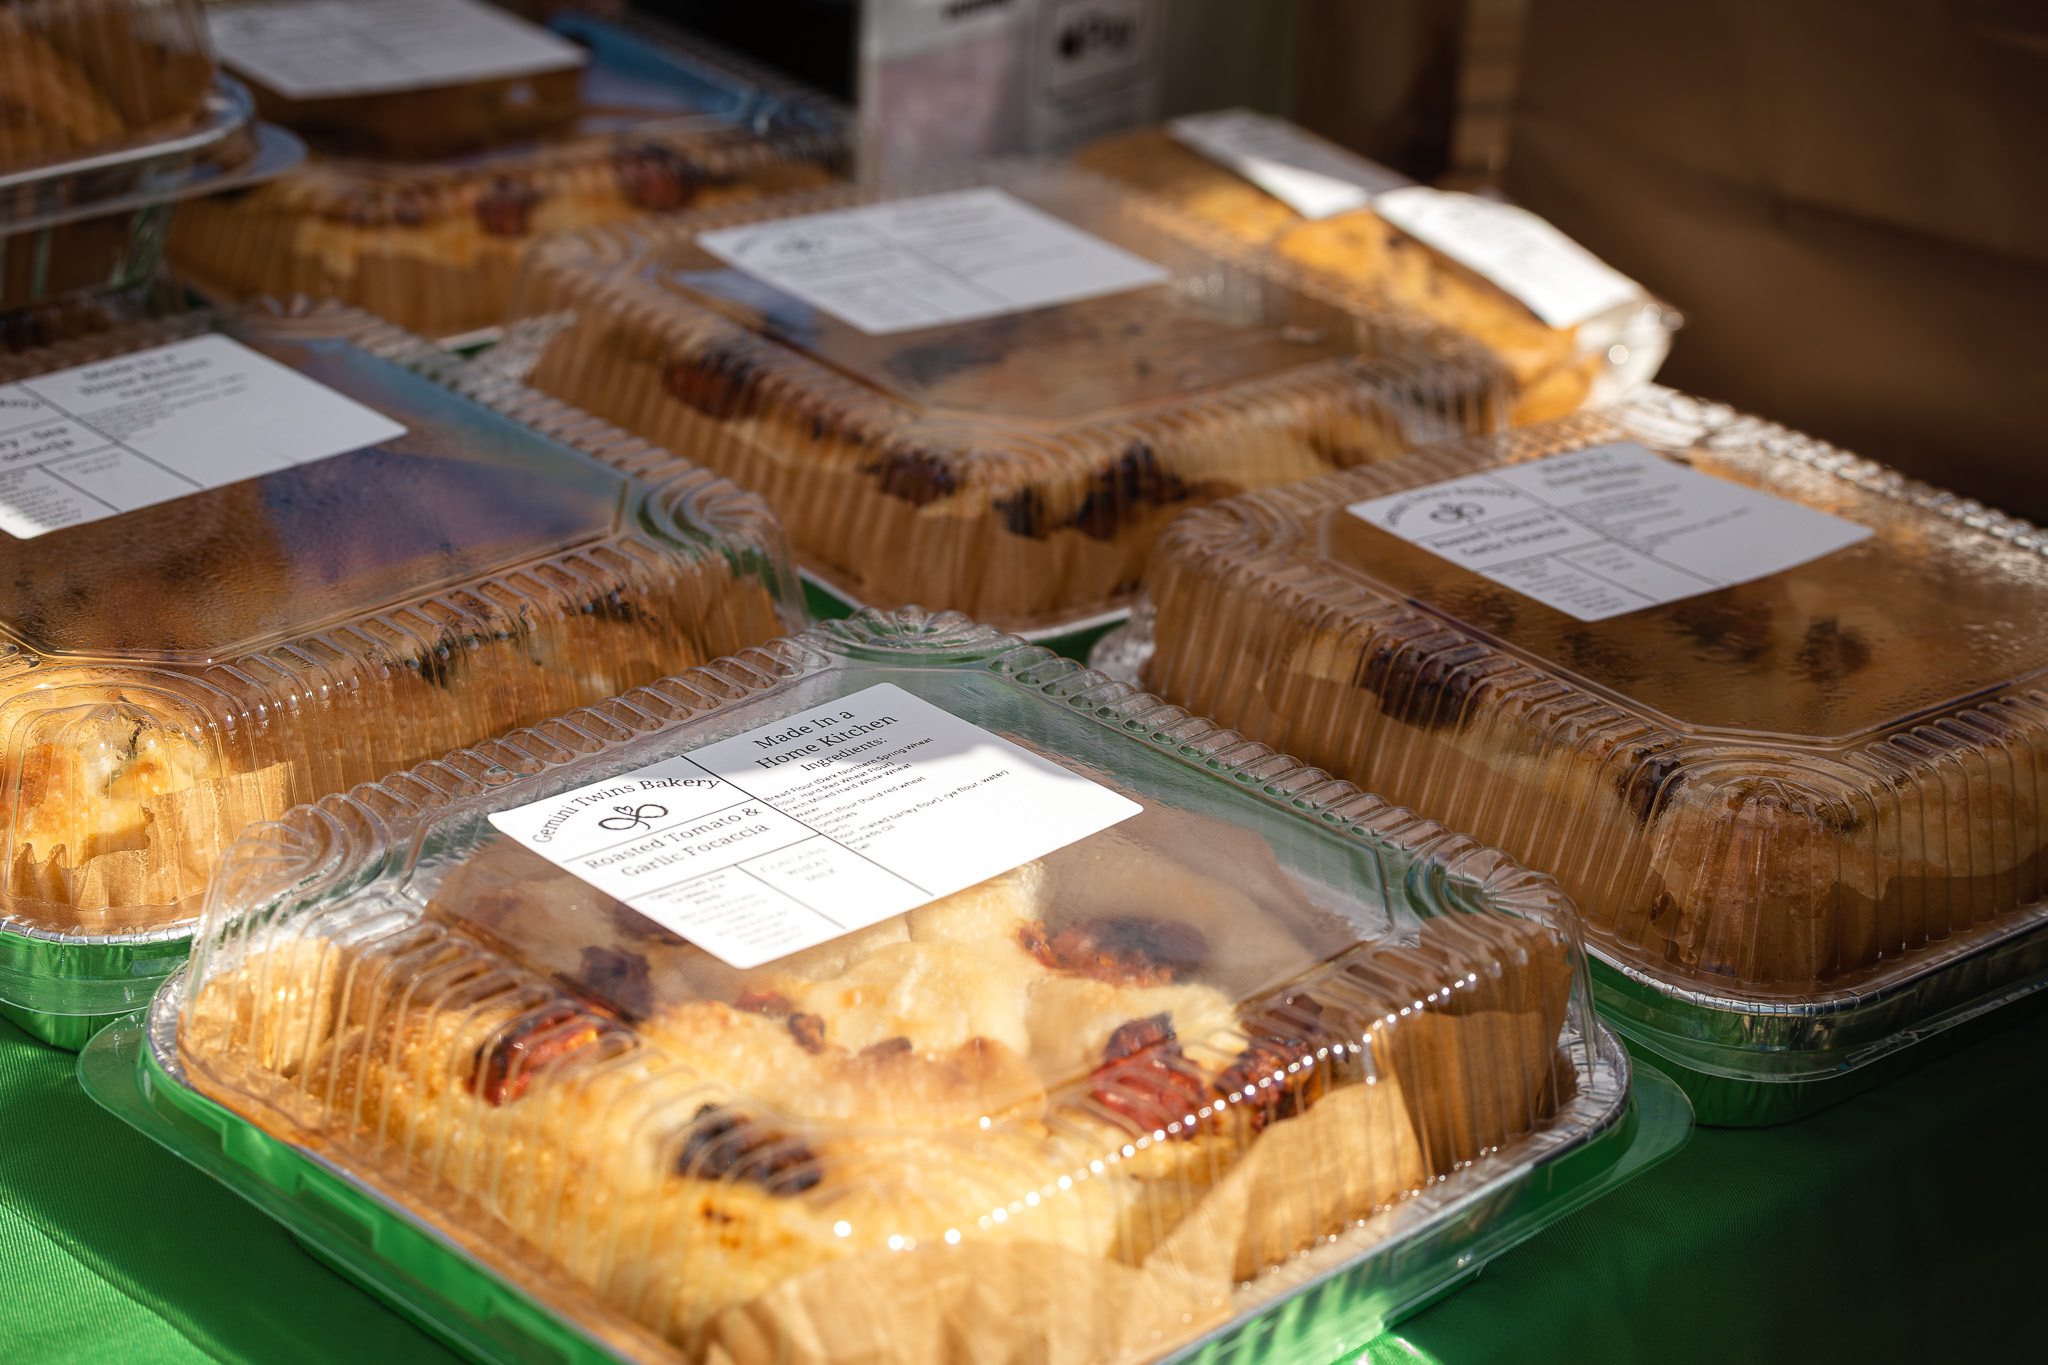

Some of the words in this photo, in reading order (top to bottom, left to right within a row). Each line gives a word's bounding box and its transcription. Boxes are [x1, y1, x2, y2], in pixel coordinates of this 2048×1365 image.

[753, 725, 814, 750] Made
[810, 715, 840, 729] In
[839, 711, 856, 720] a
[755, 743, 821, 770] Home
[818, 715, 899, 748] Kitchen
[800, 737, 888, 772] Ingredients:
[763, 790, 791, 802] Bread
[790, 782, 814, 793] Flour
[837, 758, 878, 777] Northern
[876, 747, 907, 762] Spring
[905, 737, 934, 751] Wheat
[782, 801, 809, 813] Fresh
[808, 791, 836, 804] Milled
[836, 783, 859, 793] Hard
[858, 773, 884, 786] White
[882, 763, 913, 776] Wheat
[800, 788, 822, 798] Hard
[821, 780, 841, 790] Red
[839, 771, 870, 784] Wheat
[532, 804, 580, 843] Gemini
[571, 784, 636, 807] Twins
[639, 777, 721, 790] Bakery
[794, 807, 820, 818] Water
[803, 811, 833, 824] Starter
[883, 786, 899, 795] red
[899, 776, 927, 789] wheat
[814, 811, 858, 828] Tomatoes
[858, 817, 890, 831] malted
[888, 807, 918, 821] barley
[943, 789, 959, 799] rye
[584, 838, 666, 870] Roasted
[663, 813, 742, 842] Tomato
[741, 806, 762, 817] &
[620, 853, 685, 876] Garlic
[681, 822, 770, 856] Focaccia
